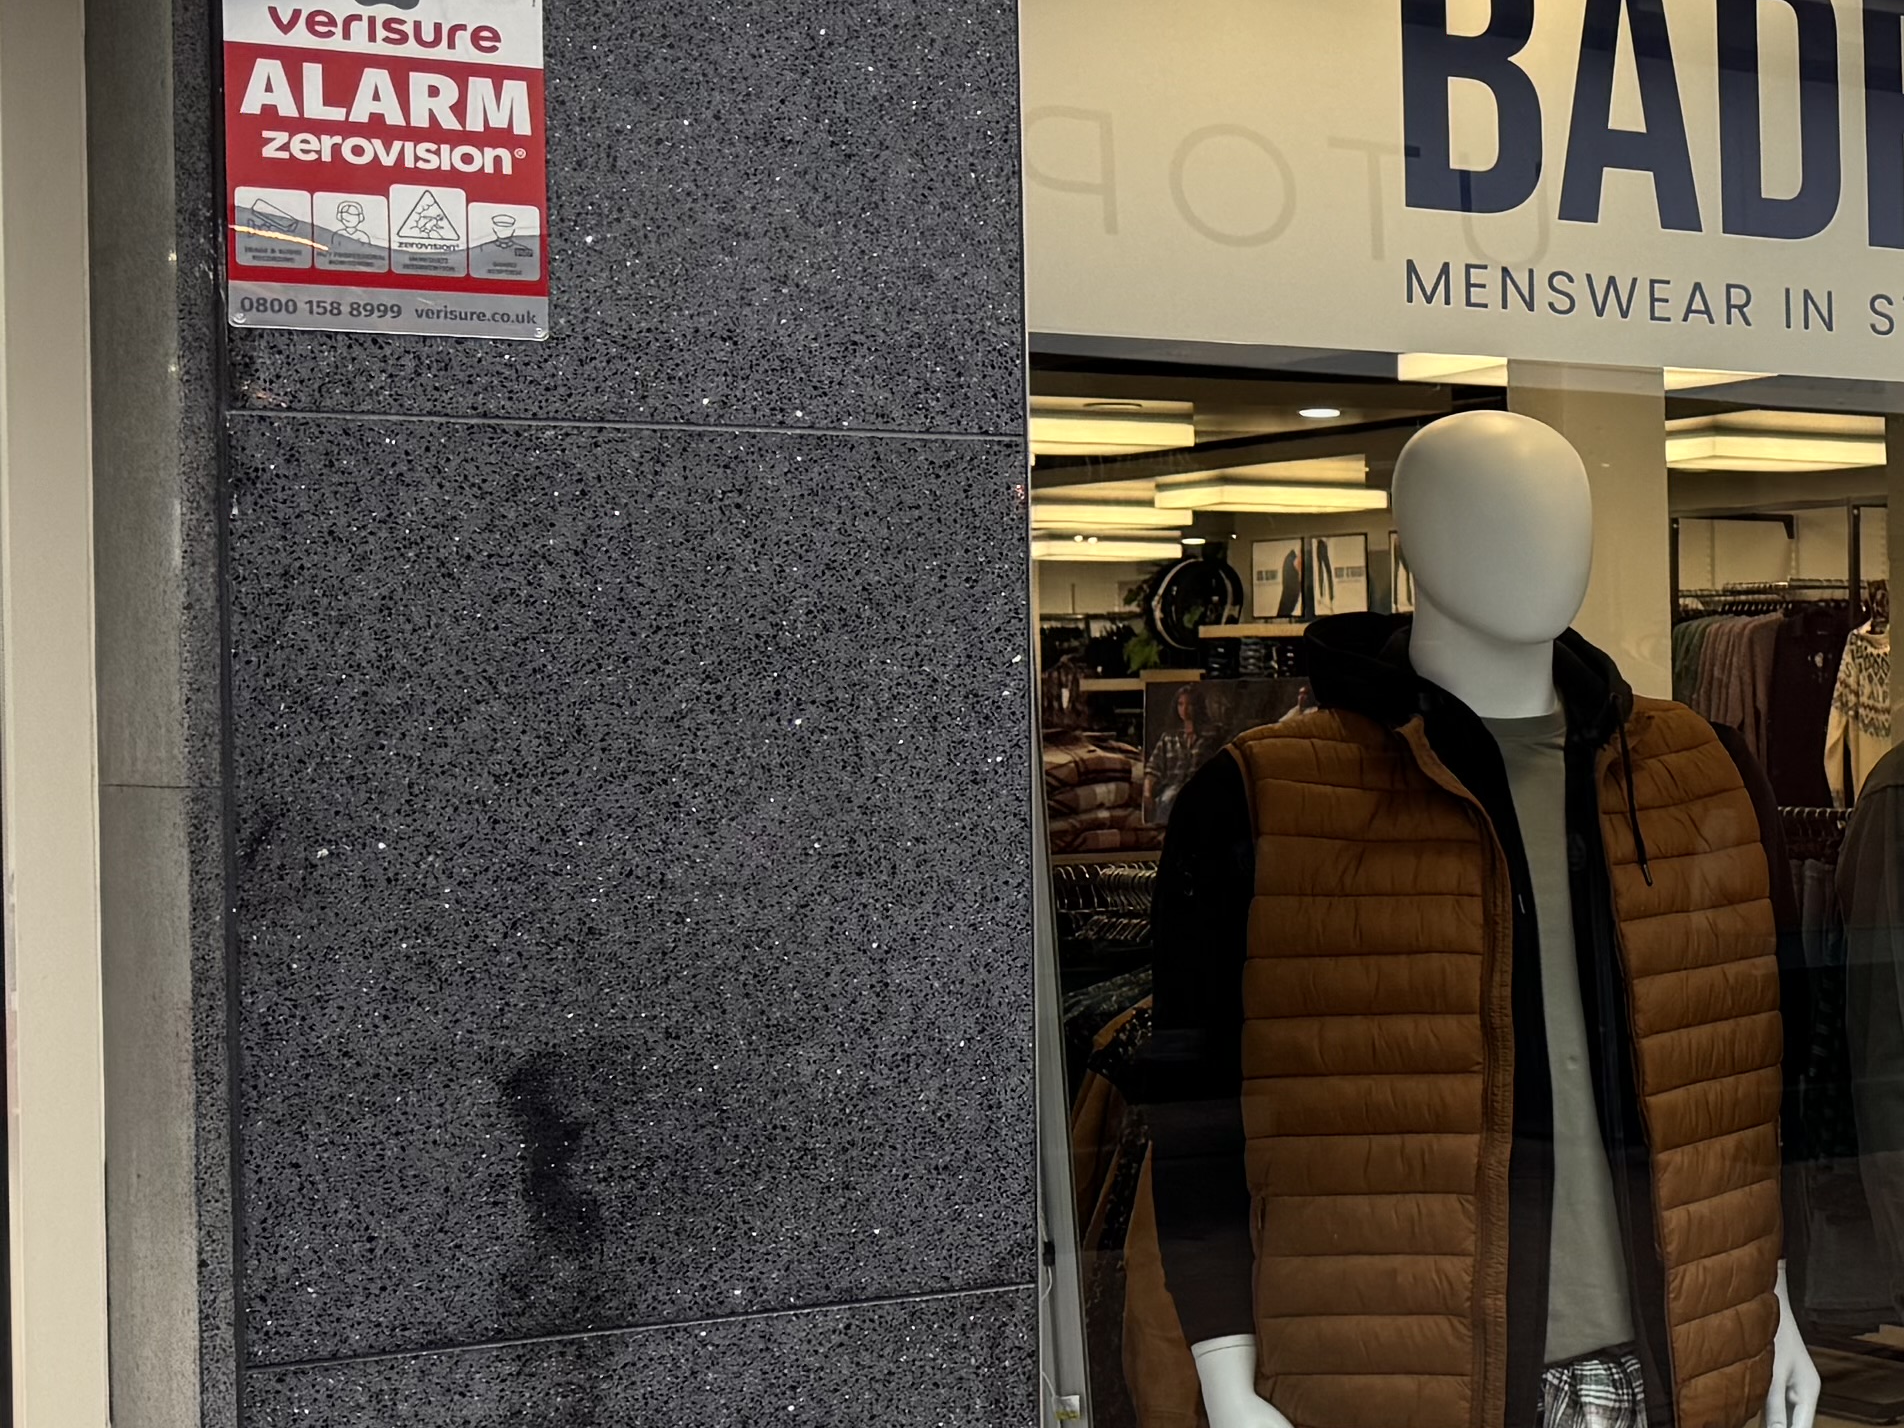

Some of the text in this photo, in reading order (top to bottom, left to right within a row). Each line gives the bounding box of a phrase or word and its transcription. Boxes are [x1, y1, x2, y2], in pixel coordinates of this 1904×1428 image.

[267, 5, 502, 54] verisure
[239, 57, 532, 137] ALARM
[240, 295, 403, 319] 0800 158 8999
[414, 306, 537, 325] verisure.co.uk
[1405, 258, 1752, 328] MENSWEAR
[1784, 287, 1834, 332] IN
